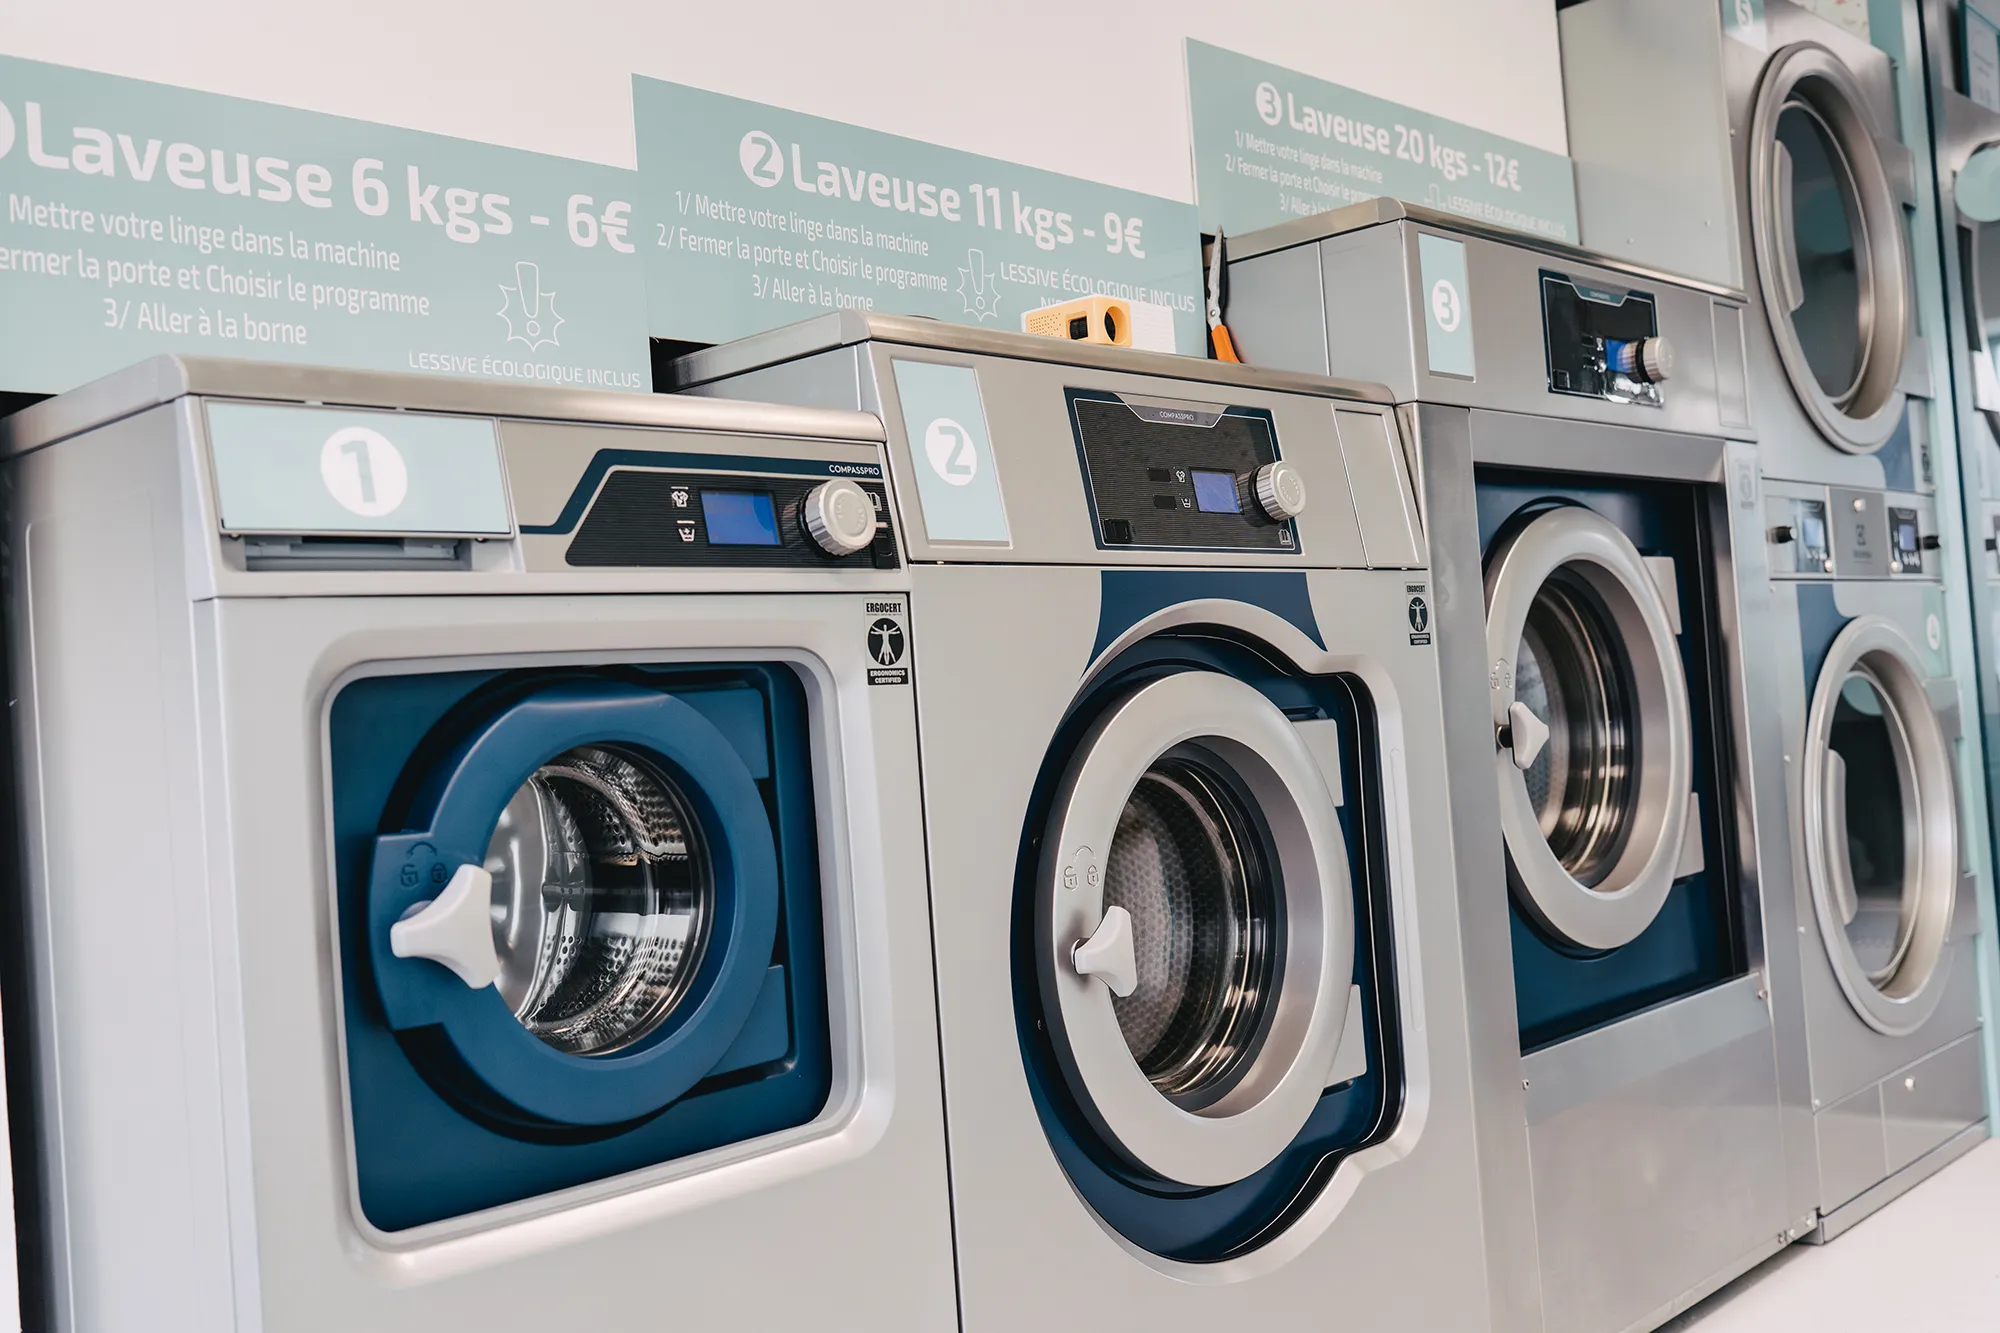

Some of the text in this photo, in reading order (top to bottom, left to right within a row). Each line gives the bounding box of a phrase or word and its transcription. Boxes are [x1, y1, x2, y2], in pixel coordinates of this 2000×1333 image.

[1245, 132, 1277, 156] Mettre
[1275, 144, 1299, 163] votre
[1320, 152, 1341, 174] dans
[1341, 157, 1350, 176] la
[1349, 163, 1383, 185] machine
[1287, 91, 1391, 155] Laveuse
[1393, 123, 1425, 165] 20
[1427, 132, 1469, 182] kgs
[1472, 163, 1482, 172] -
[1483, 151, 1522, 193] 12€
[25, 101, 636, 255] Laveuse 6 kgs - 6€
[791, 142, 962, 222] Laveuse
[968, 183, 1003, 231] 11
[1012, 190, 1075, 251] kgs
[1082, 227, 1097, 238] -
[1103, 211, 1147, 260] 9€
[1237, 156, 1269, 181] Fermer
[1269, 167, 1279, 184] la
[1279, 170, 1303, 189] porte
[1303, 176, 1313, 192] et
[1313, 176, 1341, 198] Choisir
[1341, 183, 1351, 201] le
[675, 190, 929, 257] 1/ Mettre votre linge dans la machine
[1290, 195, 1311, 216] Aller
[1447, 195, 1484, 218] LESSIVE
[8, 193, 401, 272] Mettre votre linge dans la machine
[656, 222, 948, 292] 2/ Fermer la porte et Choisir le programme
[77, 248, 100, 279] la
[107, 258, 172, 288] porte
[177, 264, 201, 291] et
[206, 264, 283, 300] Choisir
[287, 273, 307, 302] le
[312, 283, 430, 316] programme
[752, 273, 874, 312] 3/ Aller à la borne
[1000, 260, 1060, 290] LESSIVE
[1149, 288, 1196, 314] INCLUS
[103, 297, 308, 345] 3/ Aller à la borne
[408, 350, 642, 389] LESSIVE ÉCOLOGIQUE INCLUS
[828, 464, 880, 476] COMPASSPRO
[866, 602, 902, 613] ERGOCERT
[869, 669, 906, 677] ERGONOMICS
[874, 676, 902, 684] CERTIFIED
